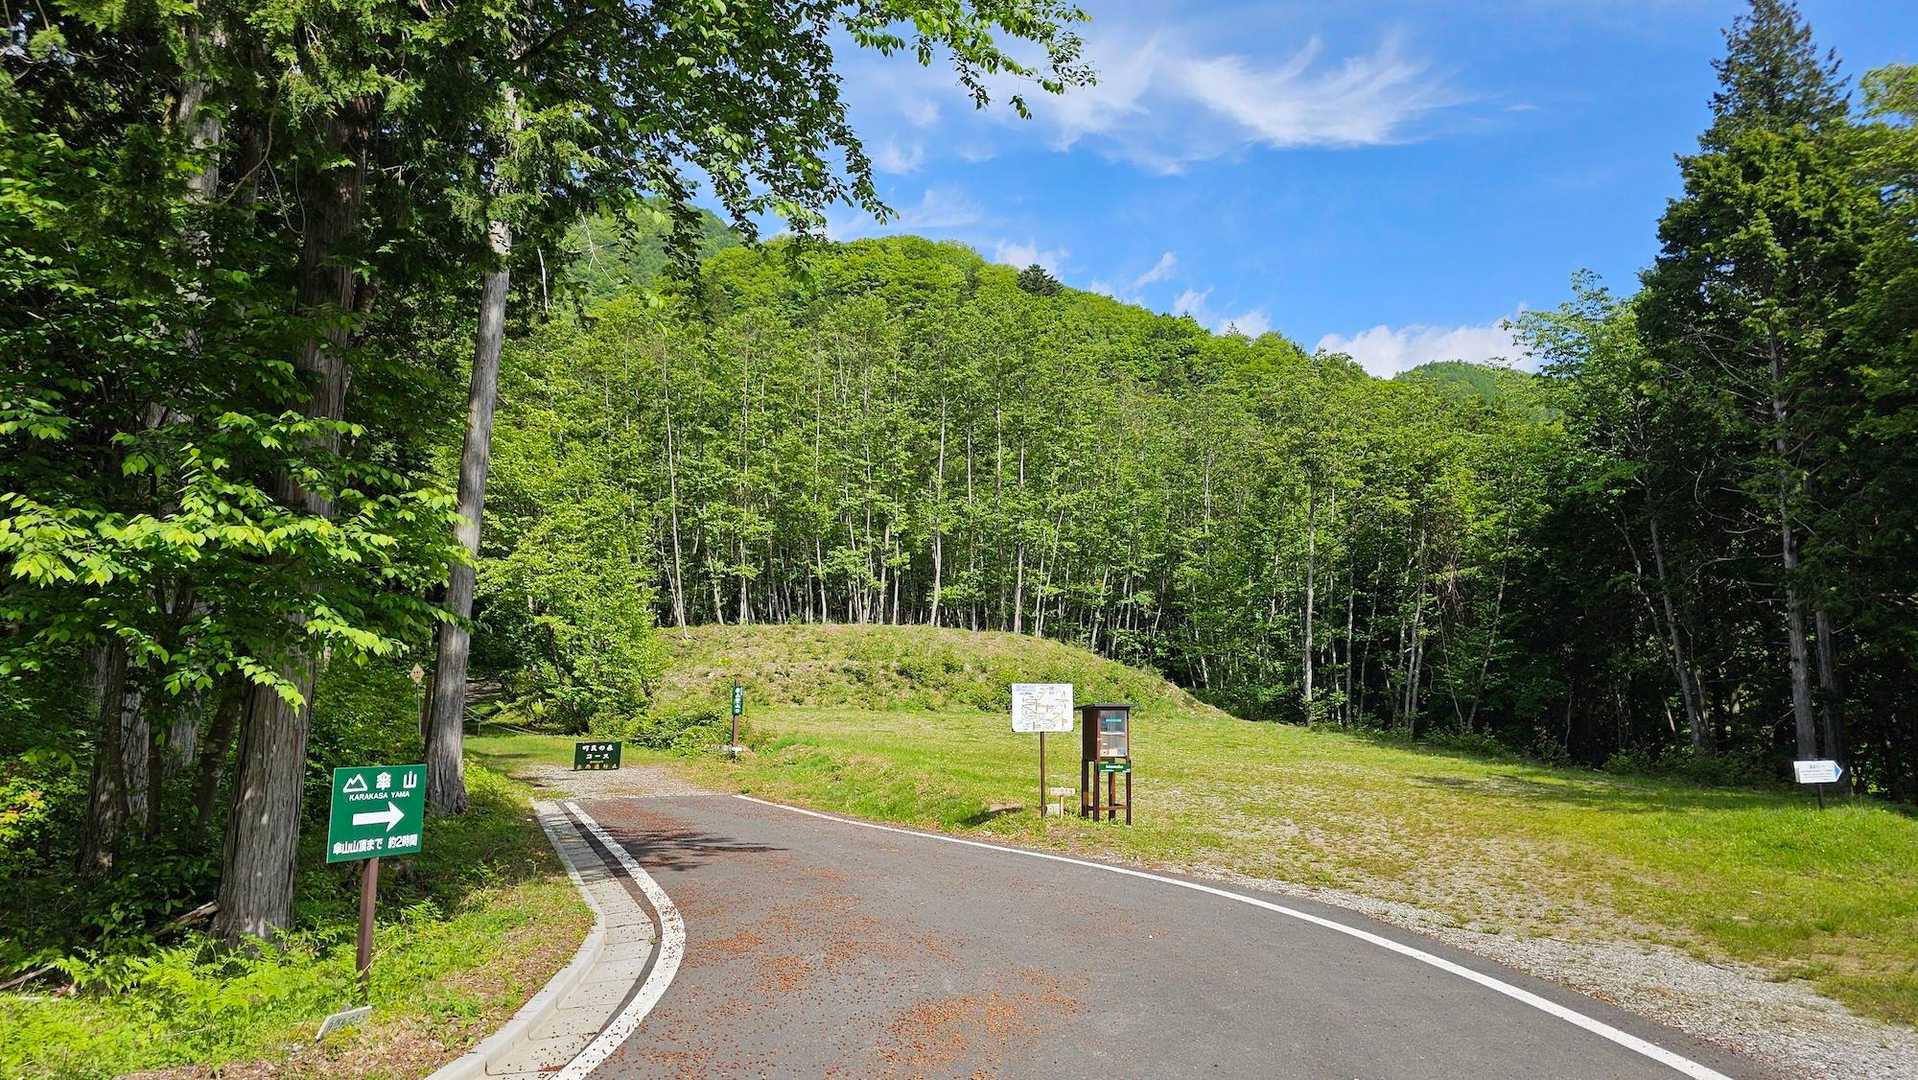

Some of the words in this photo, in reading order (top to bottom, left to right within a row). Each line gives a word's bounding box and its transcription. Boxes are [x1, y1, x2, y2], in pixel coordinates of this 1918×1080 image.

[376, 771, 417, 791] 傘山
[349, 792, 388, 801] KARAKASA
[391, 791, 410, 799] YAMA
[388, 834, 418, 849] 約2時間
